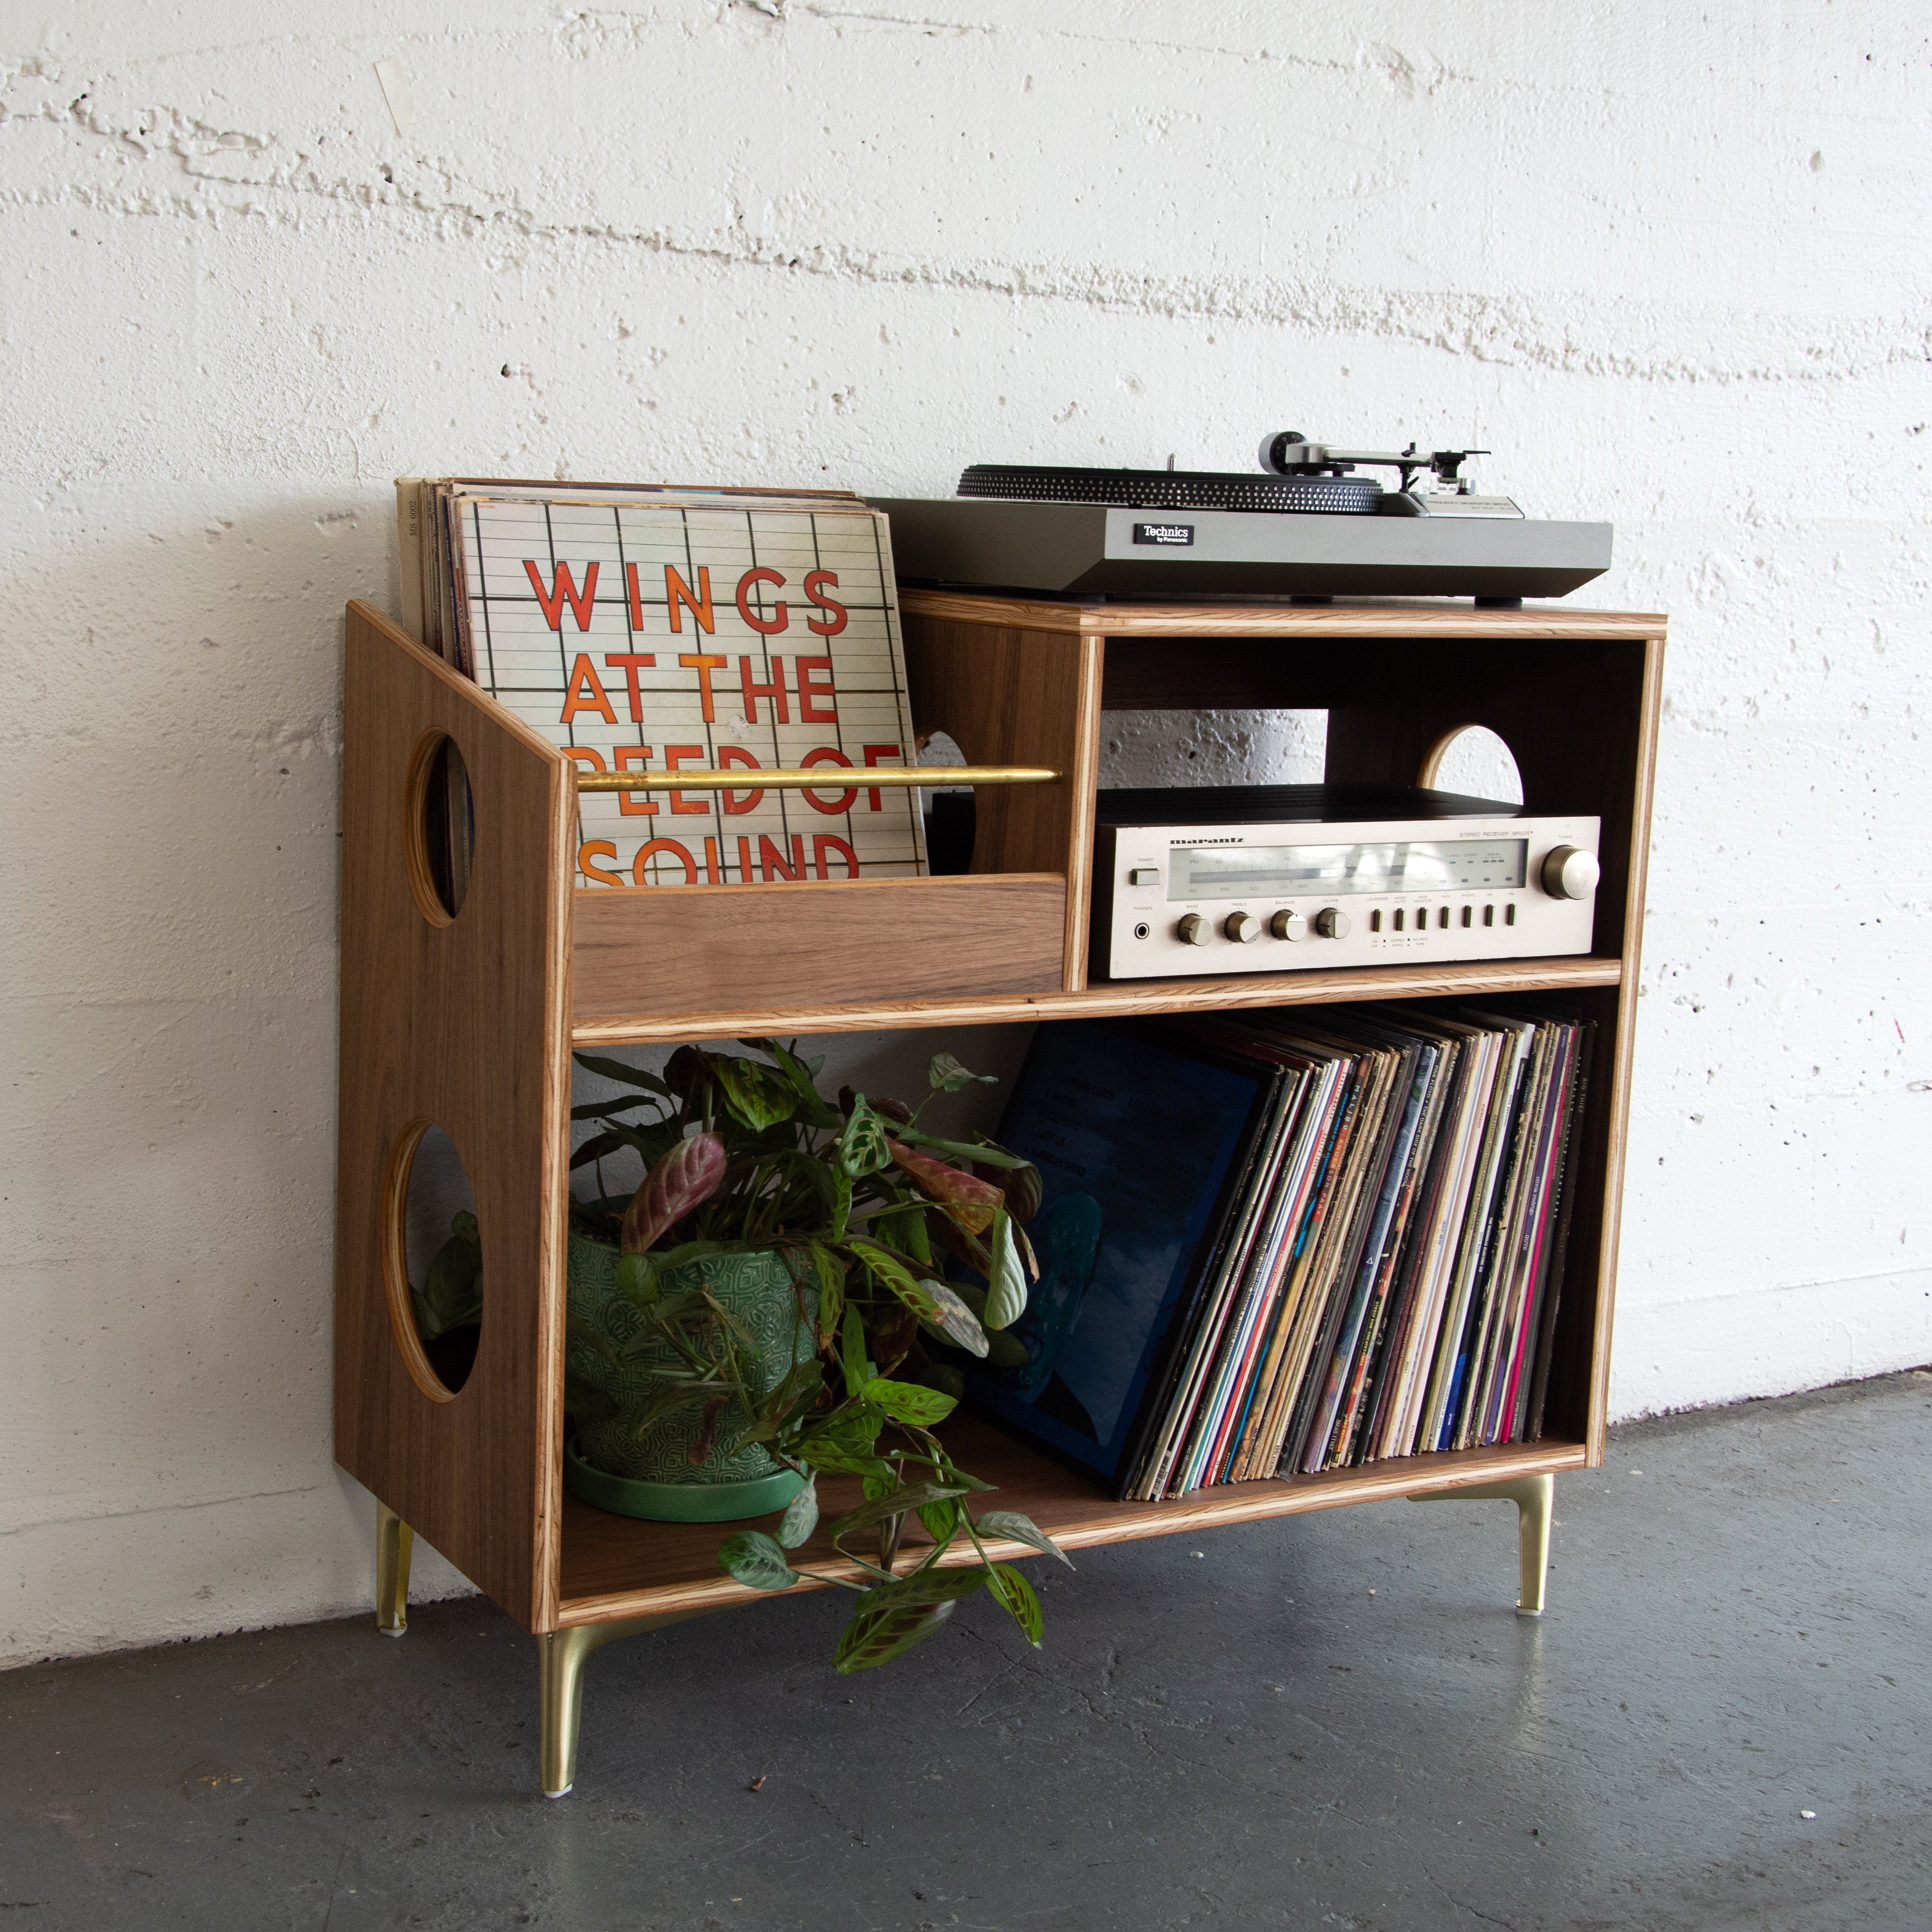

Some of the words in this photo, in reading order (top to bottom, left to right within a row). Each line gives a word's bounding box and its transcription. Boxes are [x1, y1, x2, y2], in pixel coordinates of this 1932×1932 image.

[410, 523, 418, 536] MS
[1144, 526, 1188, 537] Technics
[522, 560, 848, 636] WINGS
[559, 653, 656, 724] AT
[678, 653, 838, 724] THE
[800, 744, 901, 815] OF
[578, 834, 859, 886] SOUND
[1426, 1080, 1435, 1098] FLOYD
[1538, 1083, 1547, 1109] THELONIOUS
[1338, 1093, 1349, 1116] DURAND
[1342, 1085, 1361, 1130] MALIBU
[1577, 1094, 1586, 1113] THIEF
[1276, 1113, 1286, 1134] MUSICIAN
[1333, 1117, 1342, 1134] JONES
[1416, 1117, 1424, 1133] DARK
[1289, 1141, 1297, 1156] STEELY
[1563, 1123, 1571, 1153] BLOOD
[1316, 1152, 1331, 1188] INDICATIONS
[1324, 1138, 1344, 1187] ANDERSON
[1447, 1158, 1456, 1182] WILLIAMS
[1402, 1168, 1410, 1185] MOON
[1477, 1171, 1485, 1194] HANCOCK
[1528, 1194, 1536, 1215] rodrigo
[1557, 1218, 1568, 1253] CAPACITY
[1249, 1271, 1258, 1288] DIONNE
[1220, 1300, 1229, 1319] TOGETHER
[1241, 1291, 1251, 1311] WARWICK
[1371, 1301, 1379, 1318] STEELY
[1232, 1319, 1242, 1338] SCEPTER
[1224, 1342, 1234, 1363] RECORDS
[1245, 1438, 1254, 1459] RECORDS
[1385, 1427, 1394, 1451] RECORDS
[1267, 1456, 1276, 1473] STEREO
